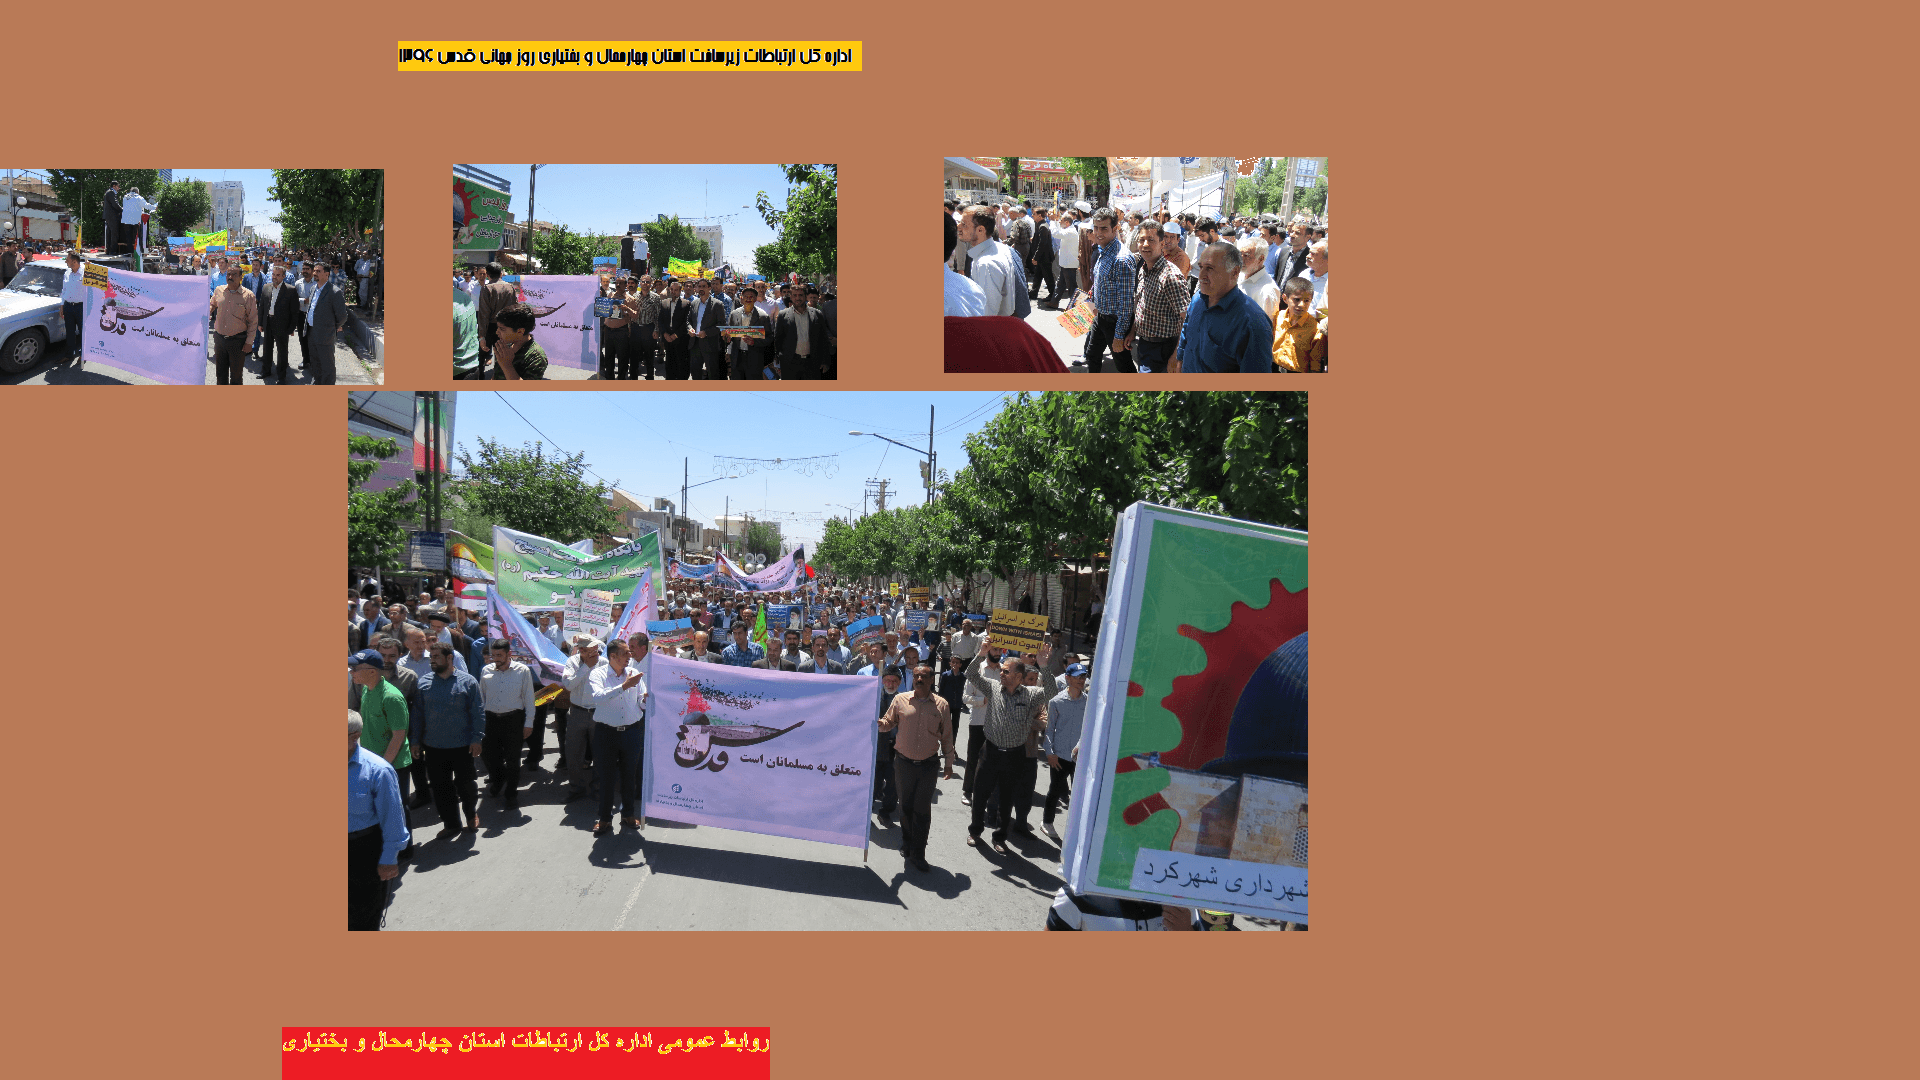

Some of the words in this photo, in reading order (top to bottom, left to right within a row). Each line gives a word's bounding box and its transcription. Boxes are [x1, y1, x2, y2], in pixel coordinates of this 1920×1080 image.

[522, 565, 563, 582] حکیم
[1019, 619, 1026, 627] بر
[1028, 616, 1045, 628] مرگ
[740, 753, 764, 764] است
[766, 756, 814, 770] مسلمانان
[817, 763, 828, 775] به
[830, 764, 862, 776] متعلق
[1143, 861, 1218, 888] شهرکرد
